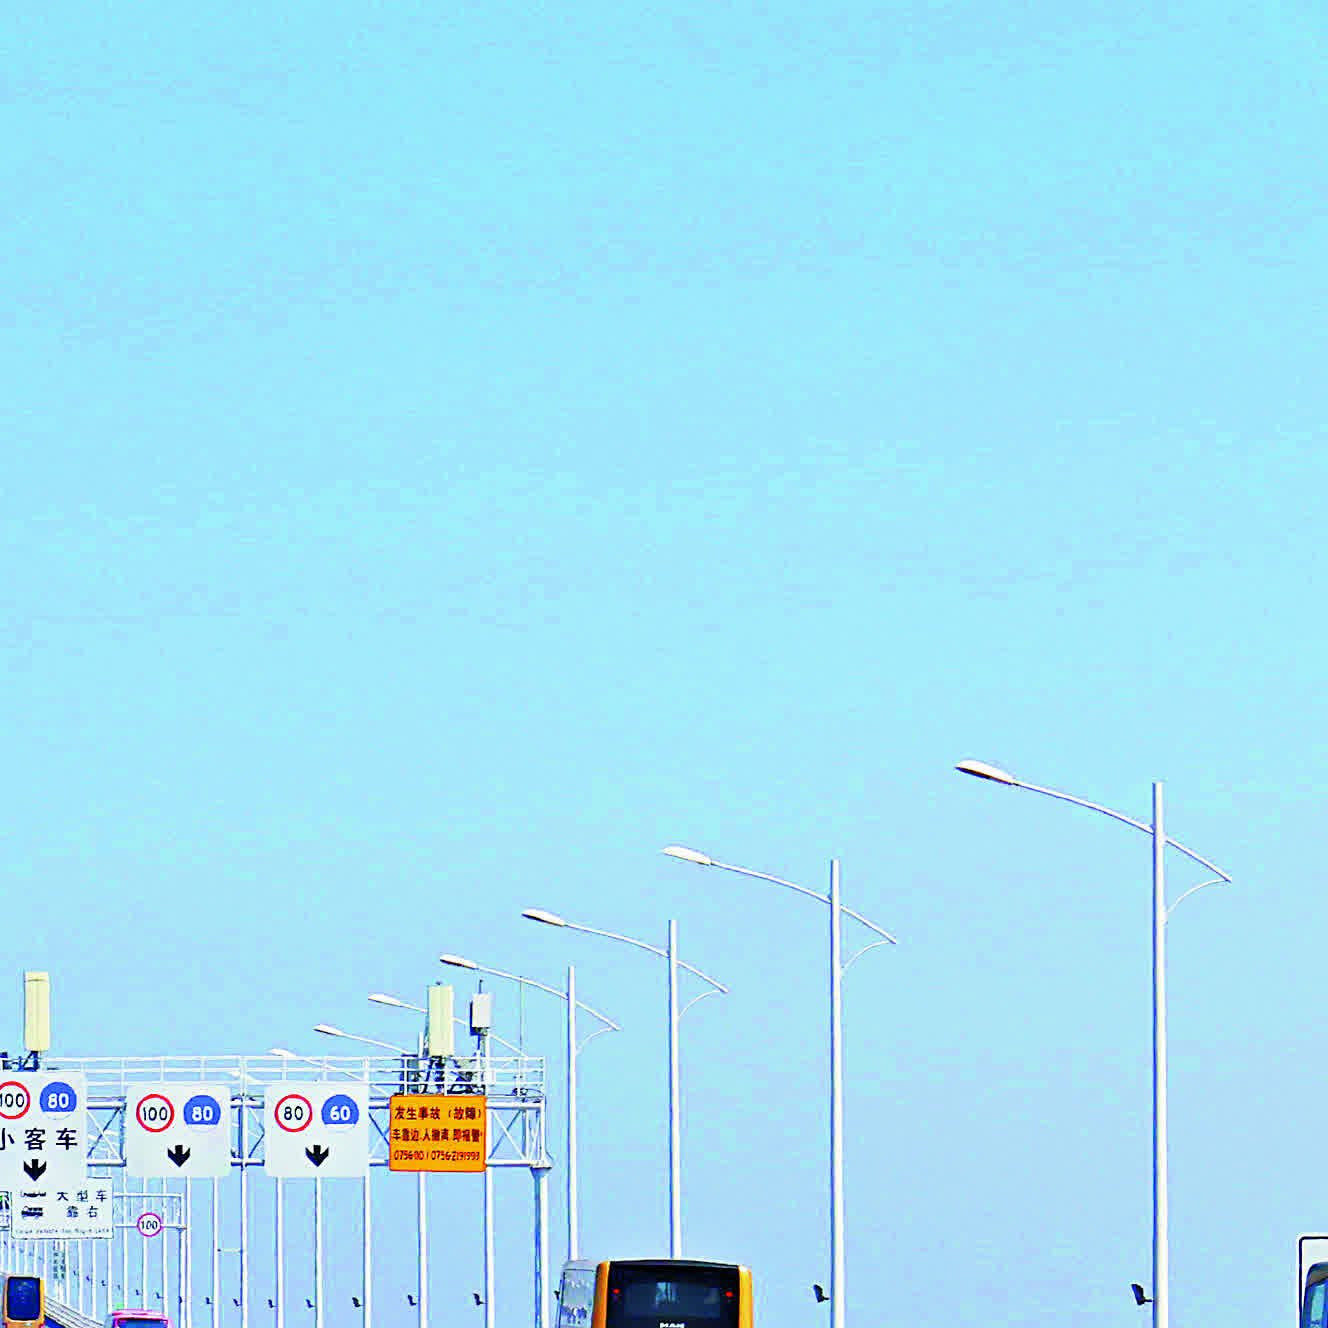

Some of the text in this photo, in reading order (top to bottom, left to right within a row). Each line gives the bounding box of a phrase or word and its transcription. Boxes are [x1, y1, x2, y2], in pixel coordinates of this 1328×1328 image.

[0, 1093, 25, 1108] 100
[47, 1093, 70, 1108] 80
[142, 1106, 168, 1121] 100
[191, 1106, 214, 1121] 80
[283, 1105, 304, 1121] 80
[329, 1106, 351, 1121] 60
[57, 1190, 108, 1202] 大型车
[140, 1219, 159, 1231] 100
